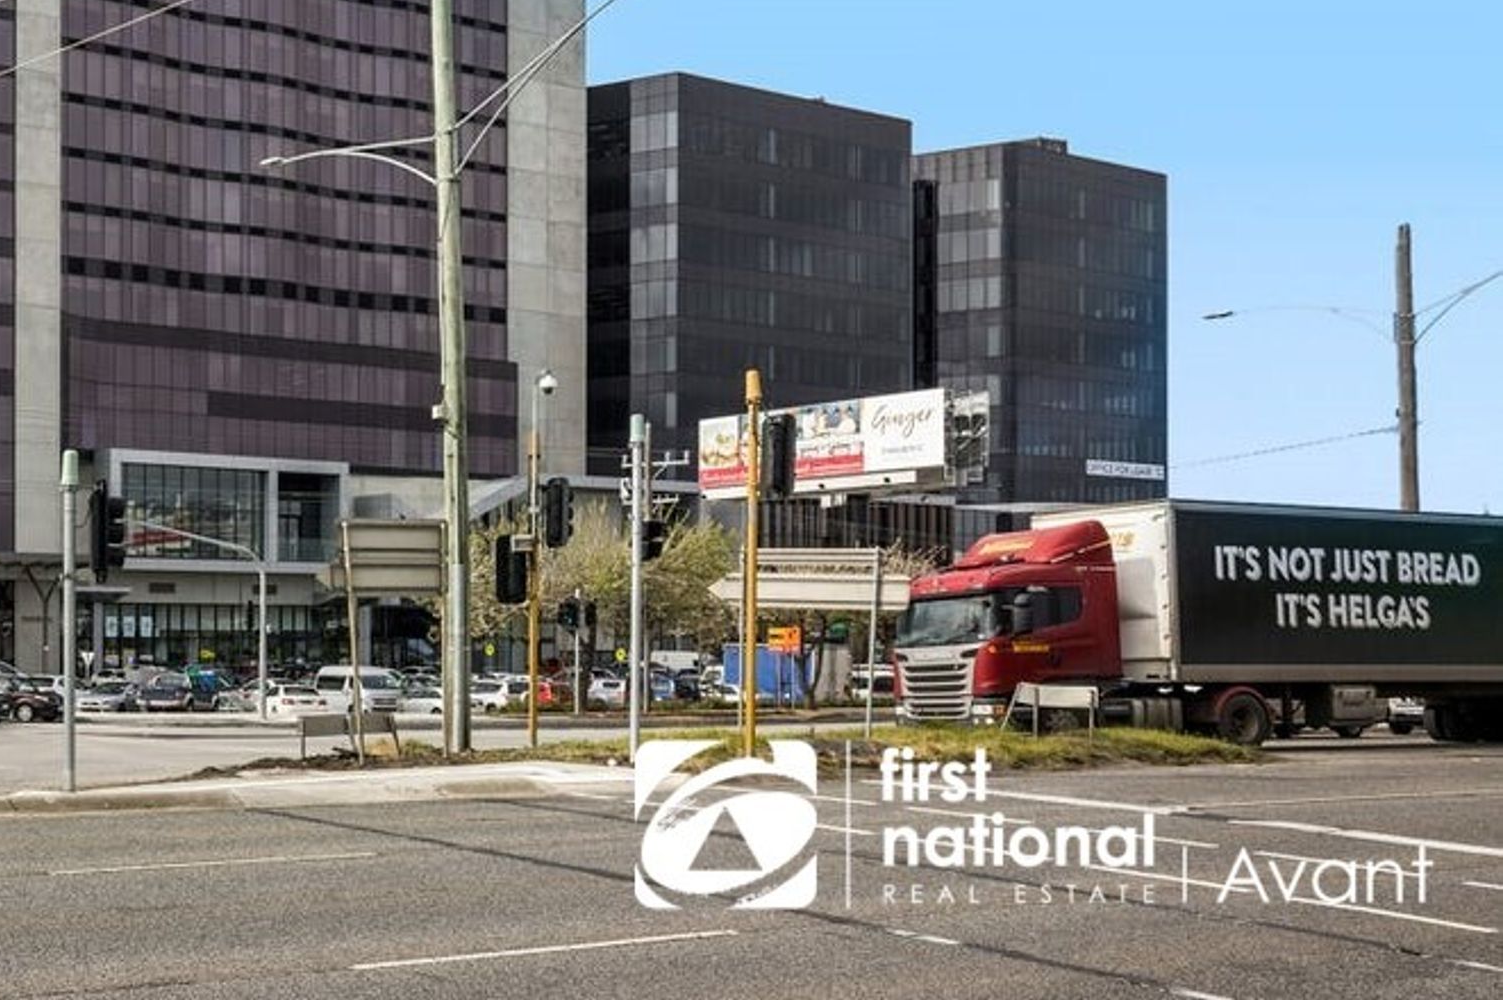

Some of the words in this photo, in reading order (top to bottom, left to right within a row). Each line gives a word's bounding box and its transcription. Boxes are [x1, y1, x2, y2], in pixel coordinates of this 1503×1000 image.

[870, 403, 934, 438] Ginger
[1214, 545, 1262, 581] IT'S
[1268, 546, 1325, 582] NOT
[1330, 549, 1391, 584] JUST
[1396, 551, 1481, 586] BREAD
[1276, 593, 1322, 628] IT'S
[1329, 594, 1431, 629] HELGA'S
